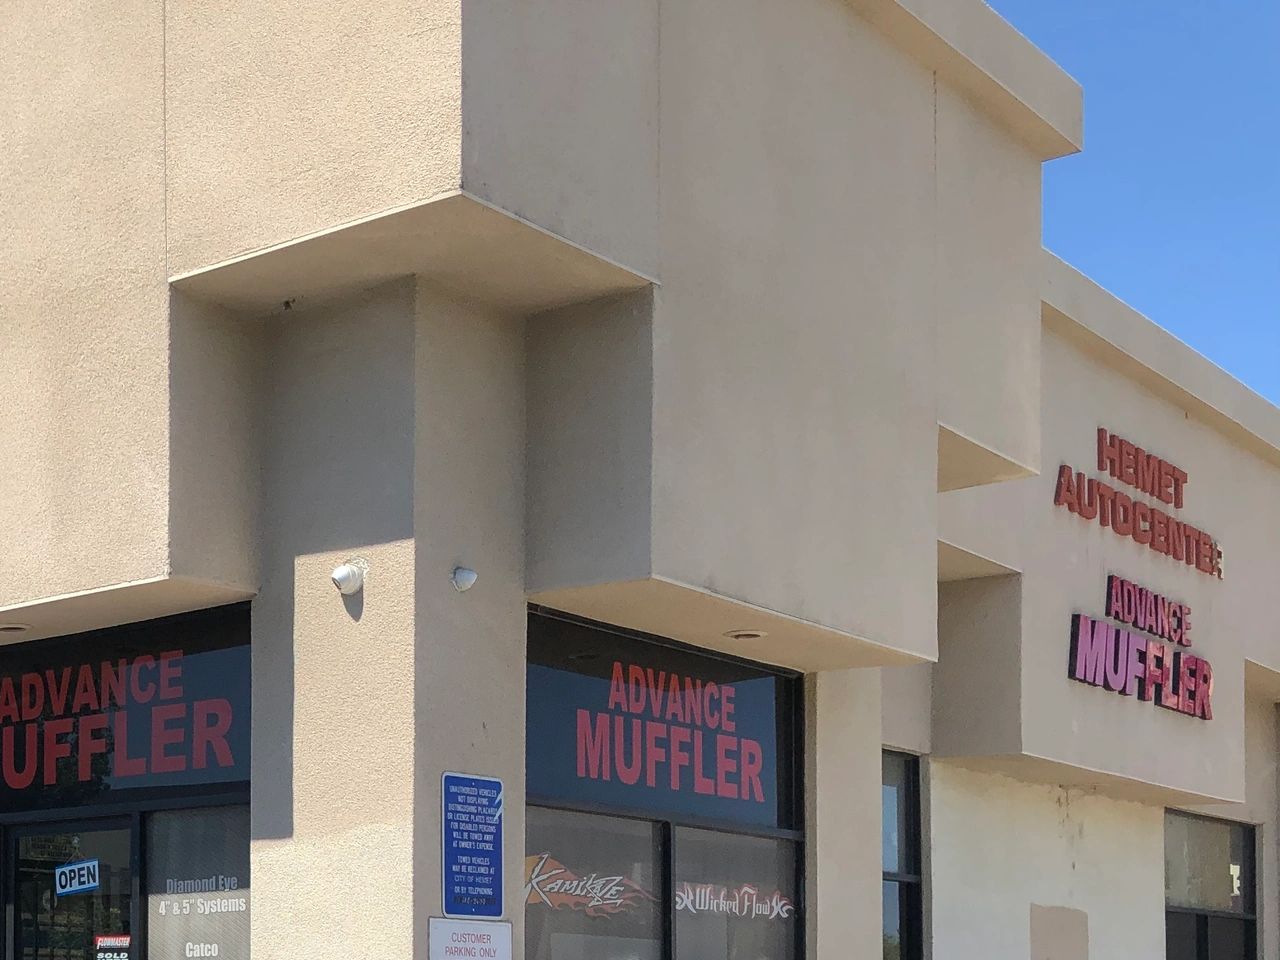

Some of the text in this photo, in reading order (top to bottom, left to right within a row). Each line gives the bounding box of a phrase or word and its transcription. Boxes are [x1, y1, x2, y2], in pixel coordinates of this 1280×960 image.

[1097, 426, 1188, 509] HEMET
[1105, 574, 1192, 648] ADVANCE
[1068, 613, 1213, 721] MUFFLER
[608, 661, 736, 732] ADVANCE
[576, 708, 765, 803] MUFFLER
[58, 864, 97, 890] OPEN
[166, 875, 238, 894] Diamond Eye
[159, 898, 246, 915] 4" & 5" Systems
[695, 886, 768, 919] Wicked Flow
[185, 942, 219, 957] Catco
[445, 946, 497, 958] PARKING ONLY
[451, 932, 492, 944] CUSTOMER
